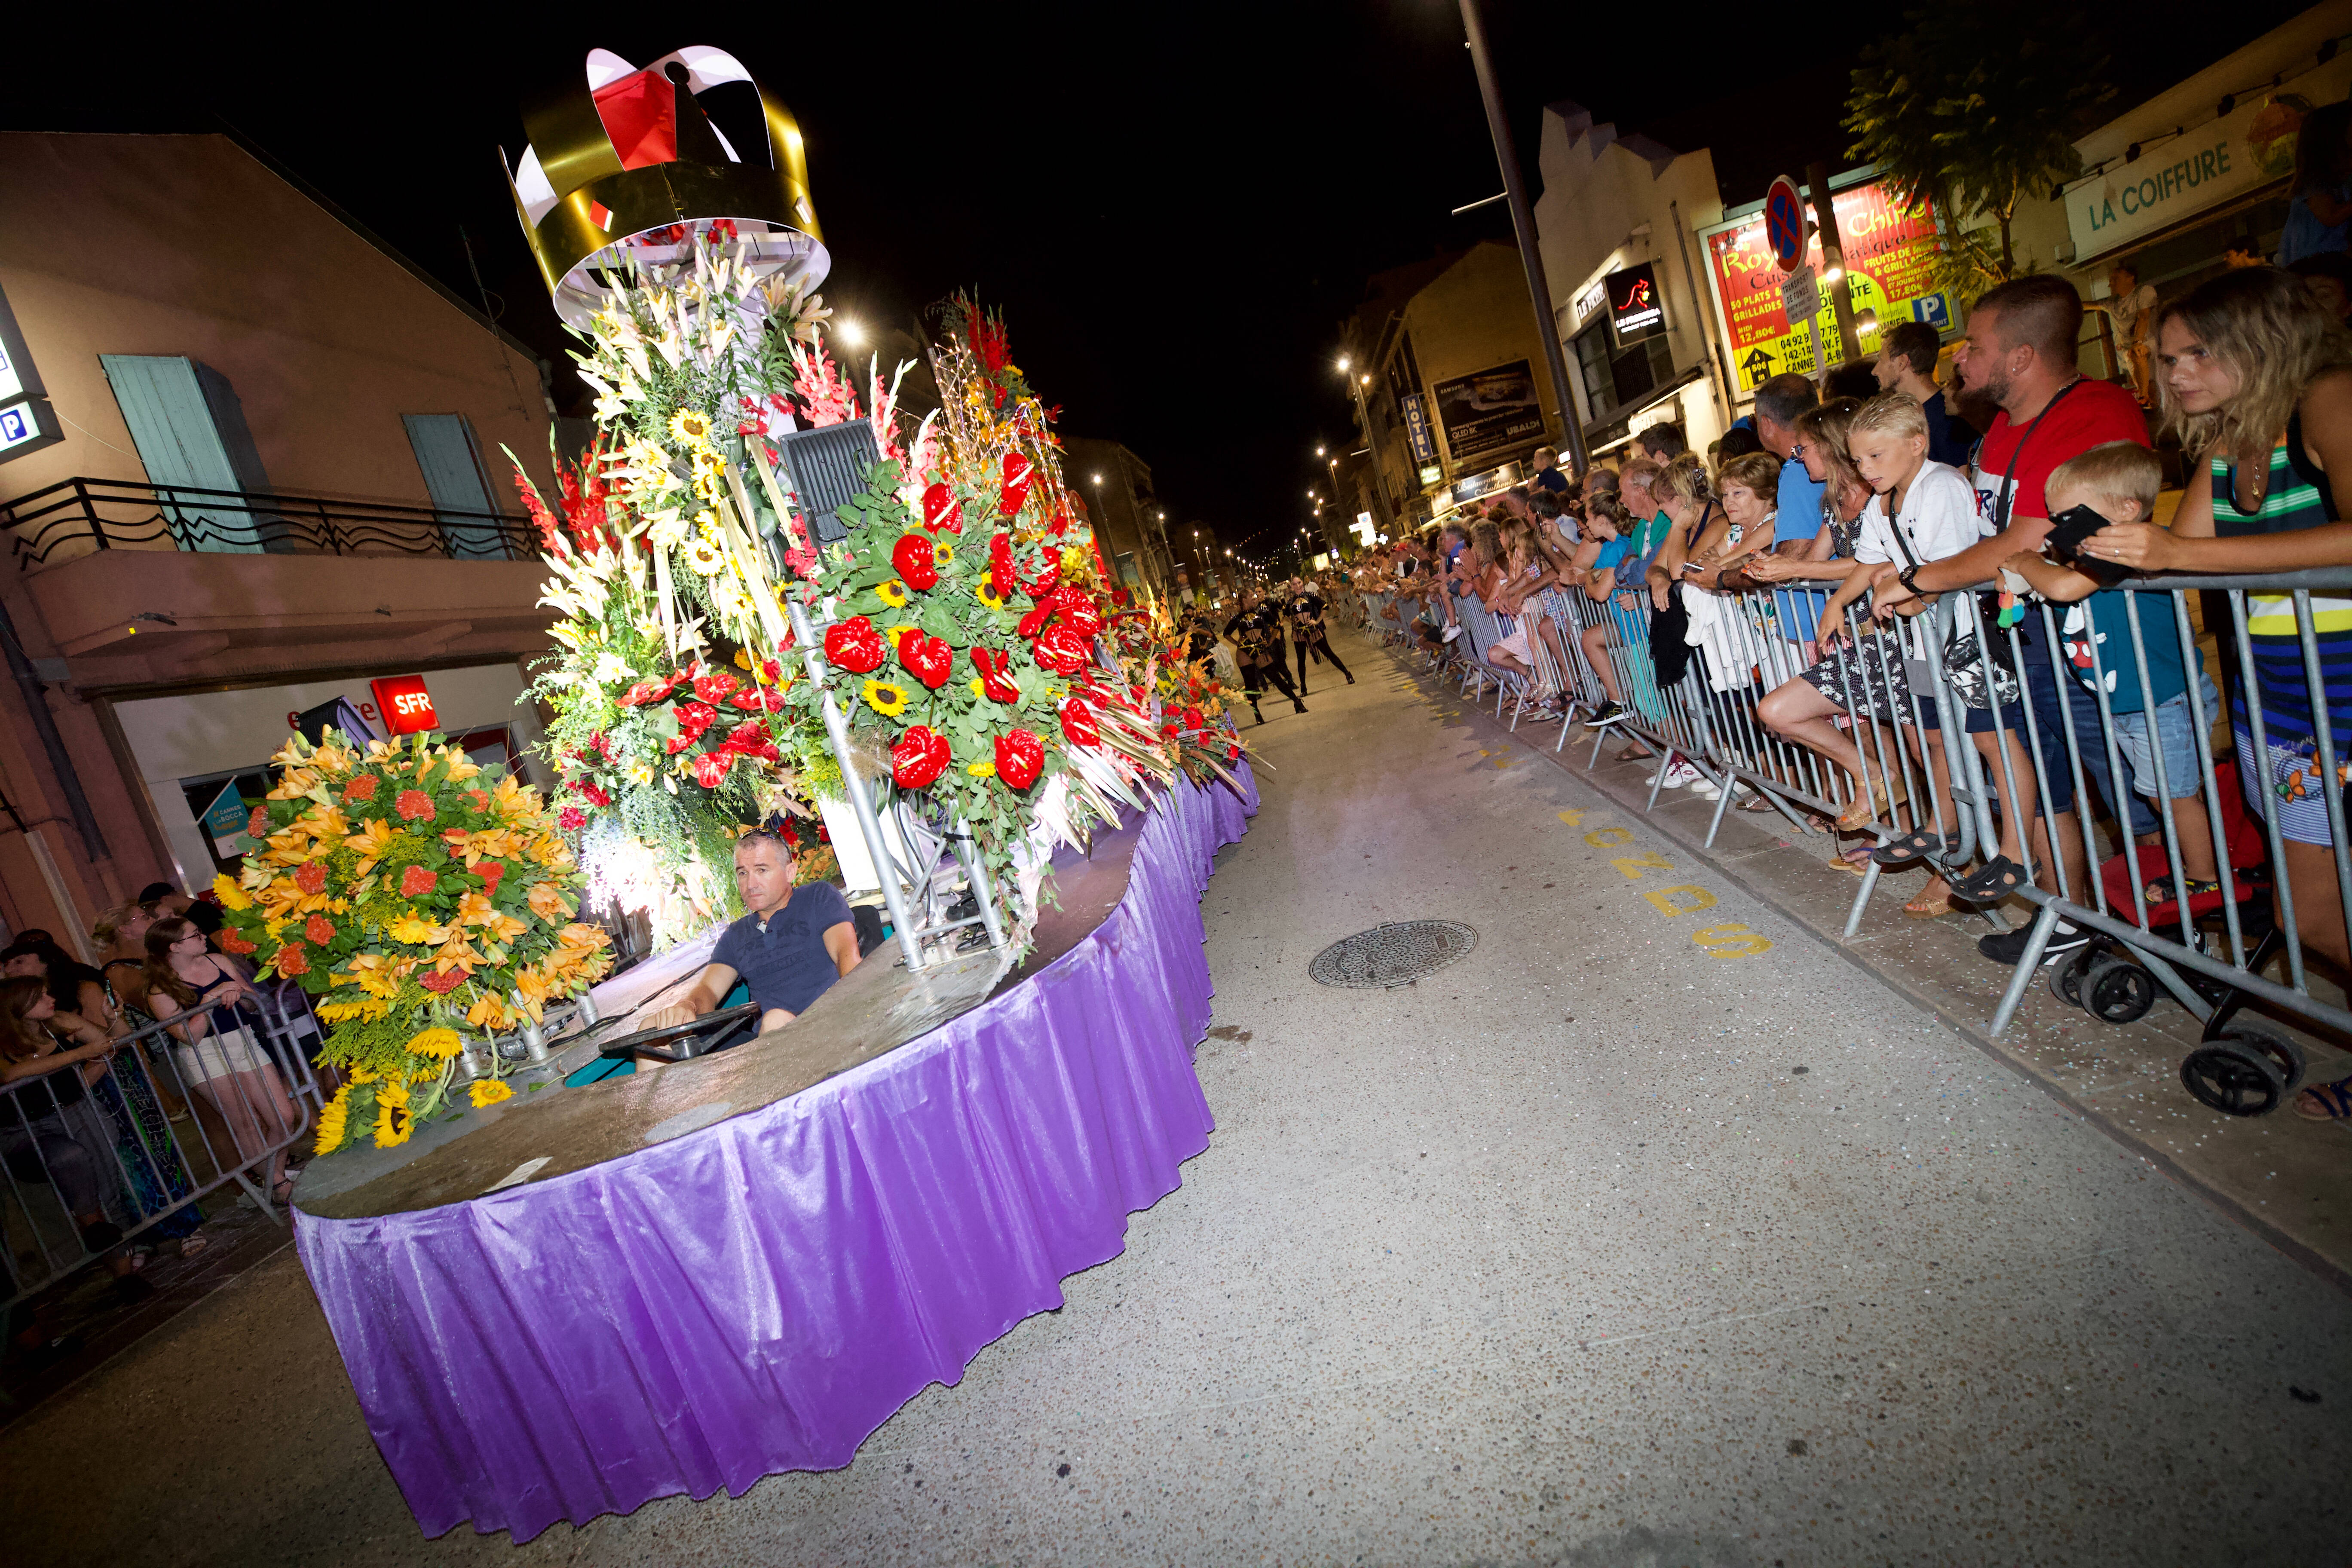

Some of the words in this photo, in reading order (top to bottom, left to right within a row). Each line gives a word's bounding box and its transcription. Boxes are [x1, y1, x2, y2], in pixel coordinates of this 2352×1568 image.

[2089, 199, 2117, 231] LA
[2122, 141, 2231, 215] COIFFURE
[1863, 252, 1896, 270] FRUITS
[1897, 247, 1911, 259] DE
[1874, 266, 1882, 277] &
[1782, 273, 1809, 294] TRANSPORT
[1730, 300, 1742, 311] 50
[1743, 289, 1771, 306] PLATS
[1786, 294, 1793, 305] DE
[1793, 285, 1809, 300] FONDS
[1733, 299, 1783, 322] GRILLADES
[1738, 324, 1753, 334] MIDI
[1739, 325, 1776, 343] 12,80€
[1780, 338, 1791, 349] 04
[1792, 334, 1803, 346] 92
[1804, 331, 1811, 343] 9
[1827, 325, 1838, 336] 79
[1754, 352, 1761, 362] A
[1786, 358, 1816, 373] CANNE
[1751, 361, 1767, 373] 500
[1758, 374, 1766, 382] m
[1407, 399, 1428, 457] HOTEL
[1452, 429, 1469, 440] QLED
[1470, 426, 1478, 436] 8K
[1506, 419, 1540, 435] UBALDI
[1456, 474, 1499, 494] Restaurant
[395, 692, 433, 715] SFR
[220, 805, 241, 815] CANNES
[221, 811, 244, 822] BOCCA
[1557, 806, 1774, 959] FONDS
